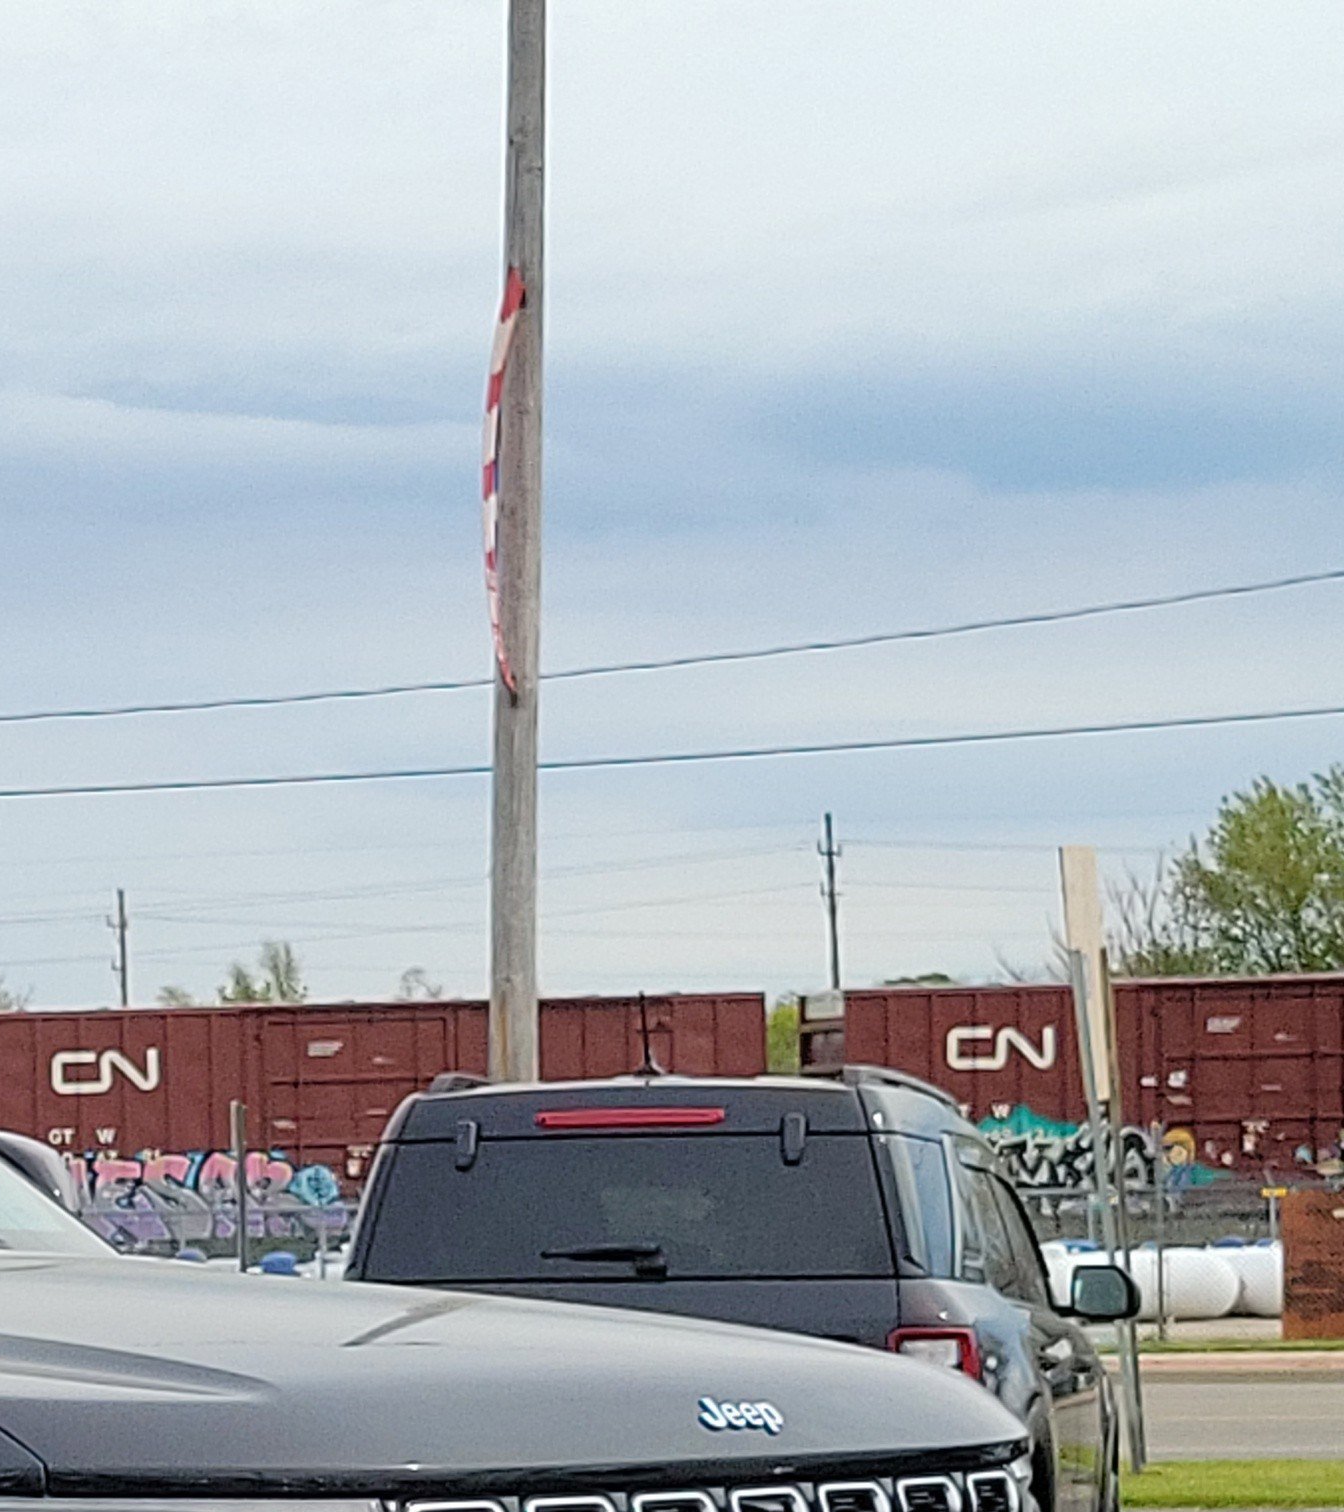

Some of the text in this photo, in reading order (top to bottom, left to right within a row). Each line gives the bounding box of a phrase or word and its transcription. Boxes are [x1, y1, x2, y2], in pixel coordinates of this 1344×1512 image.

[51, 1047, 160, 1095] CN
[945, 1024, 1057, 1071] CN
[697, 1396, 784, 1436] Jeep
